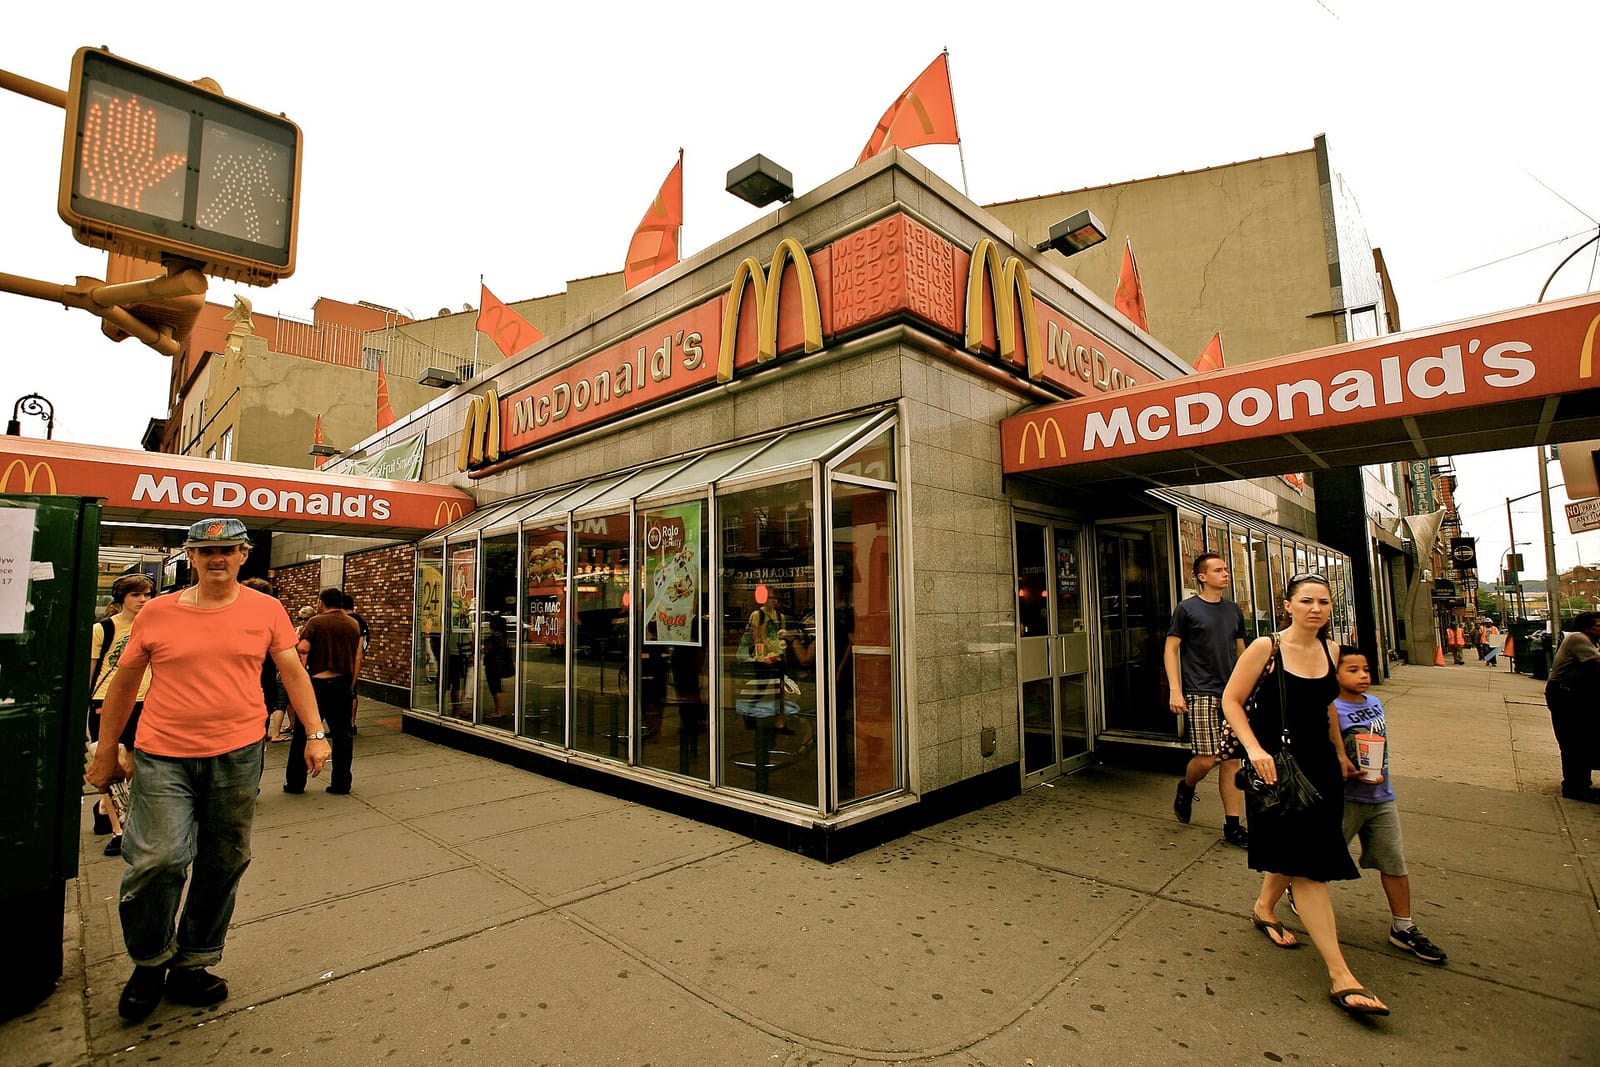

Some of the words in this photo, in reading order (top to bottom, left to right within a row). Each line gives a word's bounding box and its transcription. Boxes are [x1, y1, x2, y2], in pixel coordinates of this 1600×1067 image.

[512, 330, 705, 435] McDonald's
[1083, 338, 1536, 452] McDonald's
[131, 474, 392, 520] McDonald's
[1566, 503, 1579, 516] NO
[662, 525, 679, 538] Rolo
[423, 581, 440, 611] 24
[544, 601, 561, 613] MAC
[1347, 704, 1383, 724] GREAT
